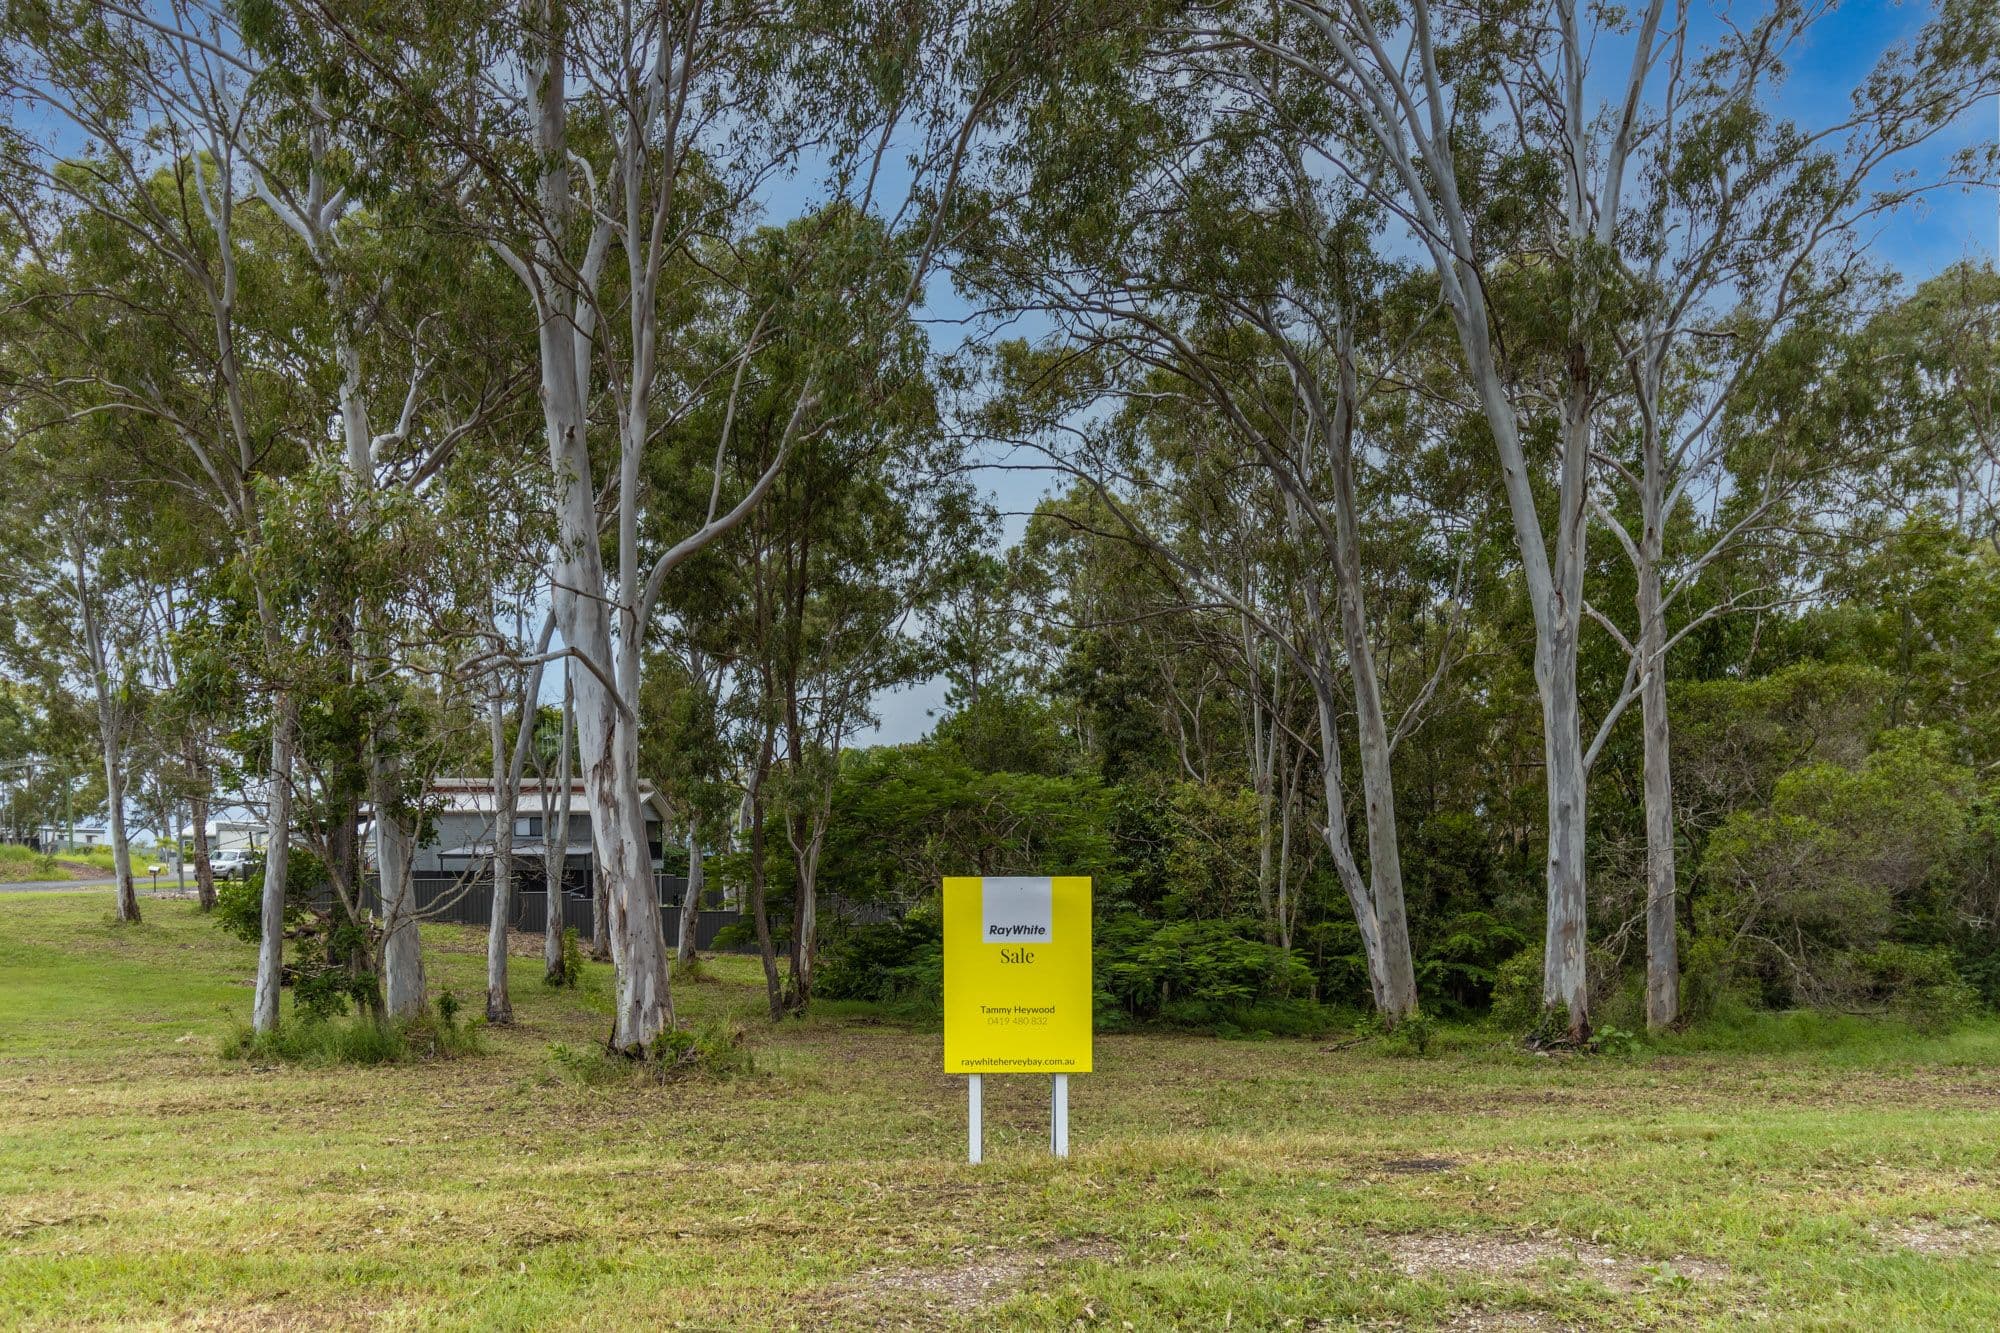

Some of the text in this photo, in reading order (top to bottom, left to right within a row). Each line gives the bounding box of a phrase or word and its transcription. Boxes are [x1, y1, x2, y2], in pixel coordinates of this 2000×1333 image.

[1000, 948, 1035, 964] Sale
[980, 1005, 1056, 1015] Tammy Heywood
[987, 1017, 1010, 1025] 0419
[1031, 1017, 1048, 1025] 832
[961, 1057, 1075, 1067] raywhiteherveybay.com.au
